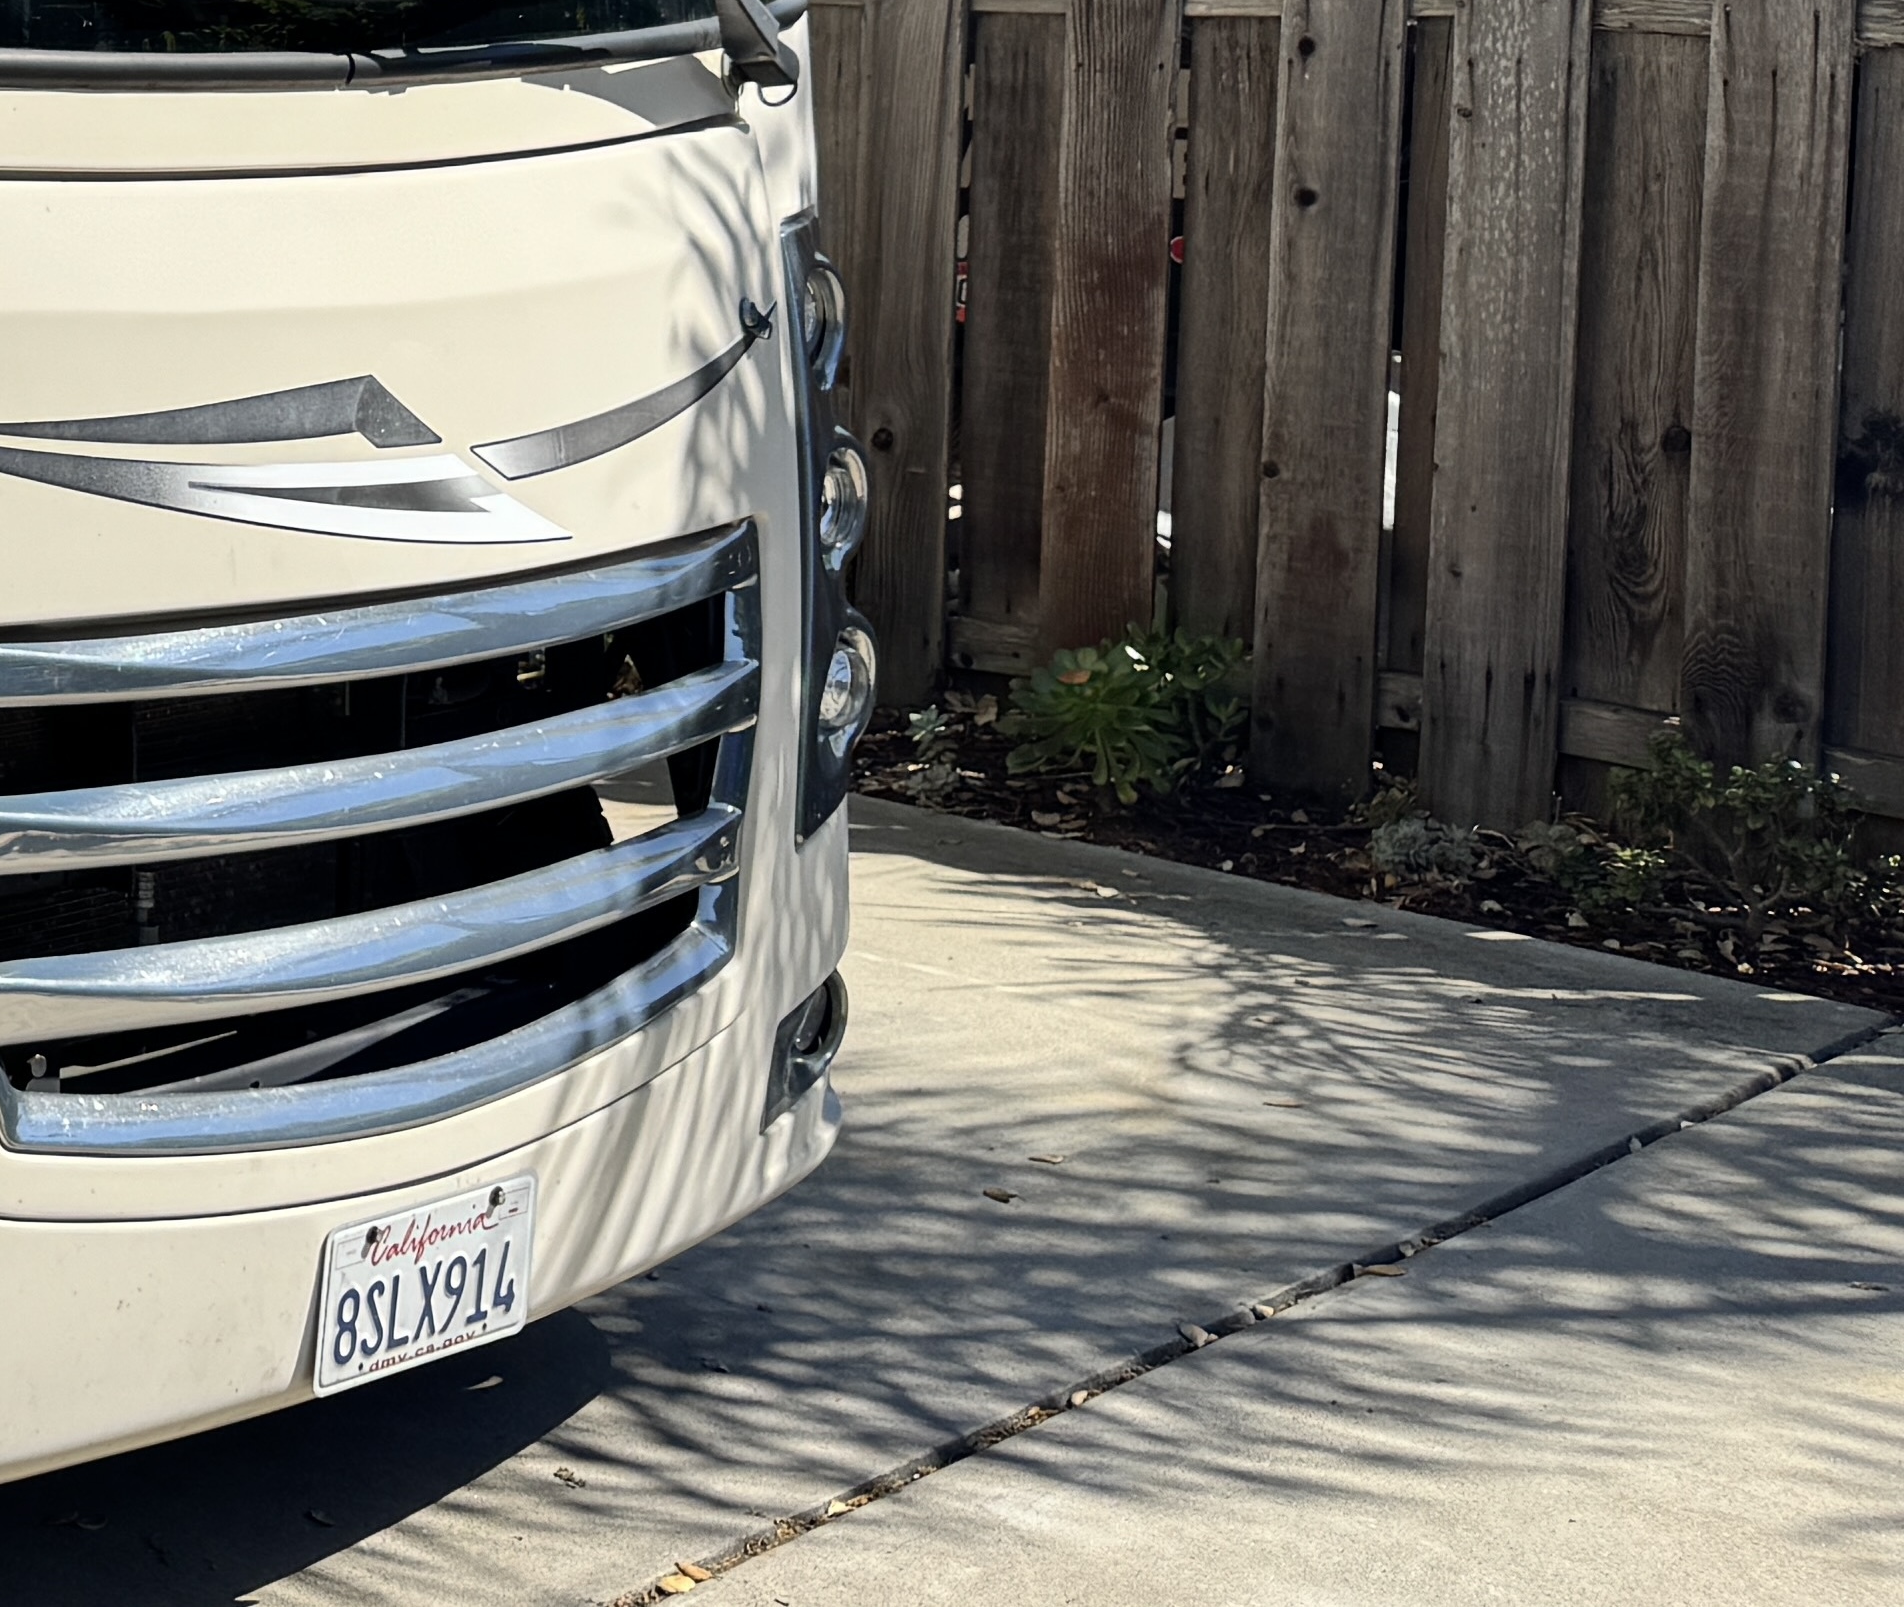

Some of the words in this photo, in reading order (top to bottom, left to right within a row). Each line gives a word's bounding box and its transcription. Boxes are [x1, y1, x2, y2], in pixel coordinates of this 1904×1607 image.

[370, 1206, 499, 1266] California
[333, 1241, 516, 1365] 8SLX914
[368, 1330, 477, 1372] dmv.ca.gov
